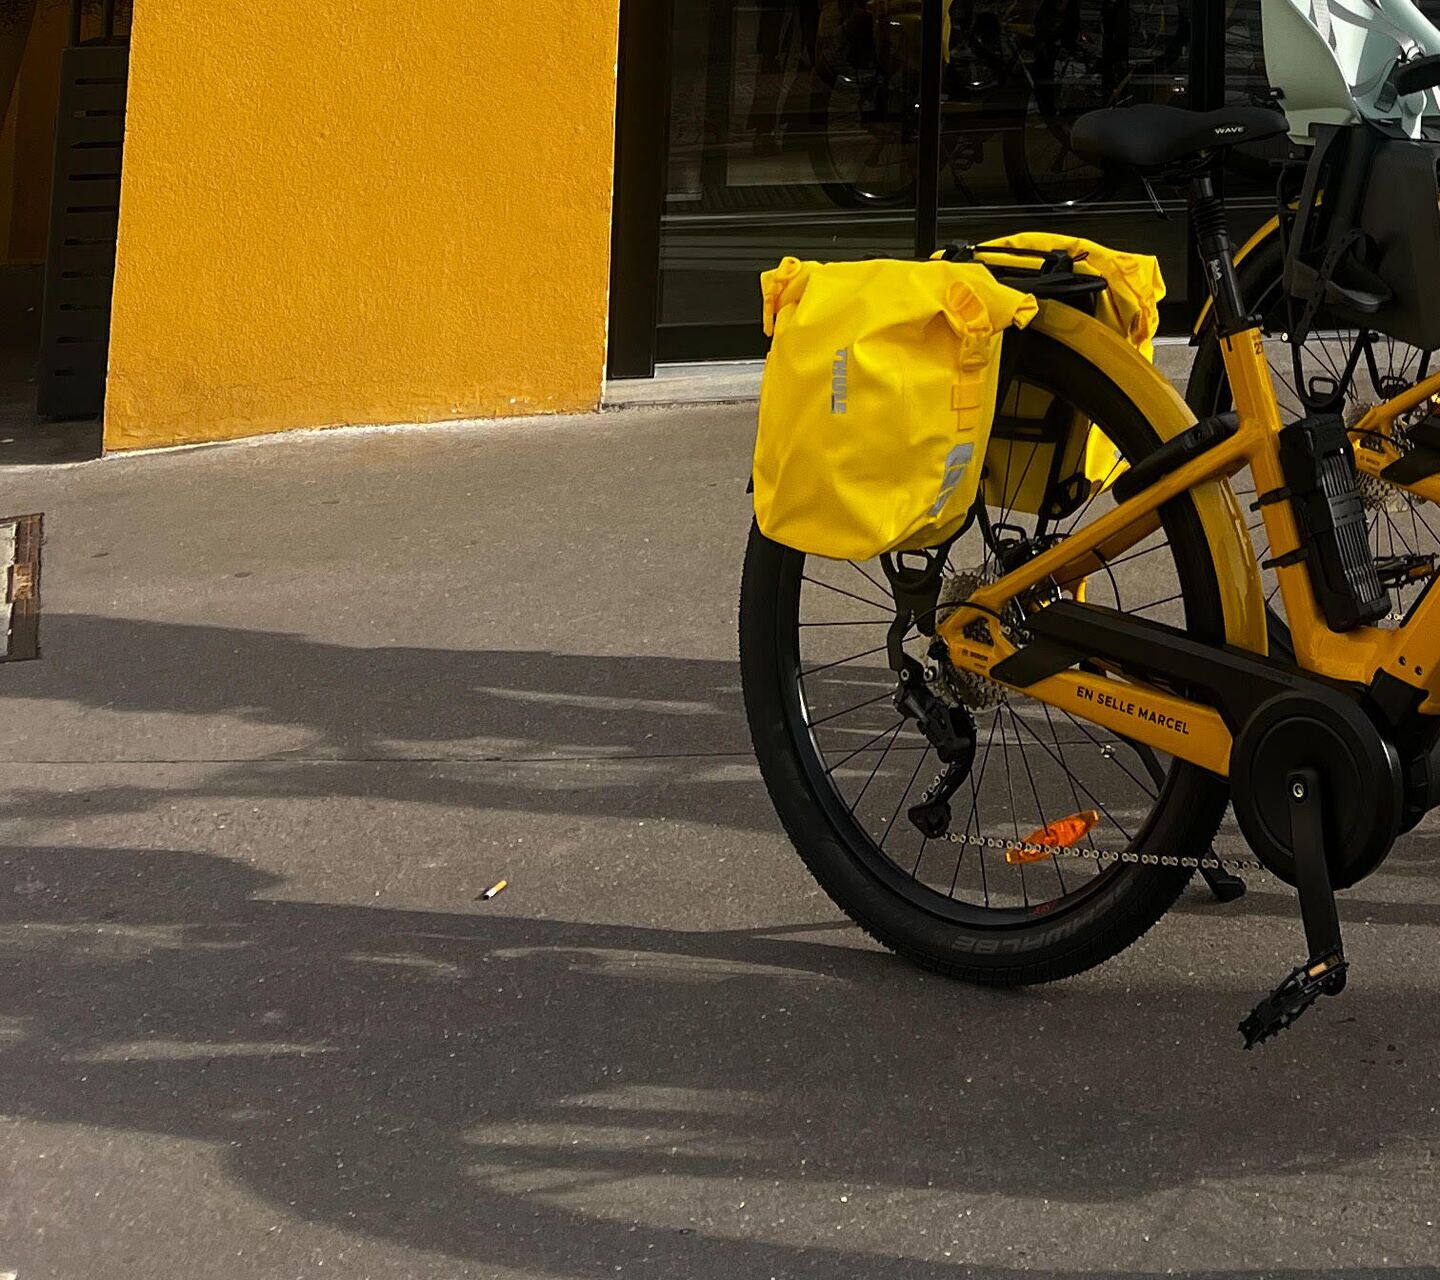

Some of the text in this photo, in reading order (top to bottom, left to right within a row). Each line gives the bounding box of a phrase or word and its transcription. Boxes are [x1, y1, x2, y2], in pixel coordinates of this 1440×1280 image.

[1214, 126, 1245, 135] WAVE
[831, 347, 848, 415] THULE
[1076, 685, 1190, 735] EN SELLE MARCEL
